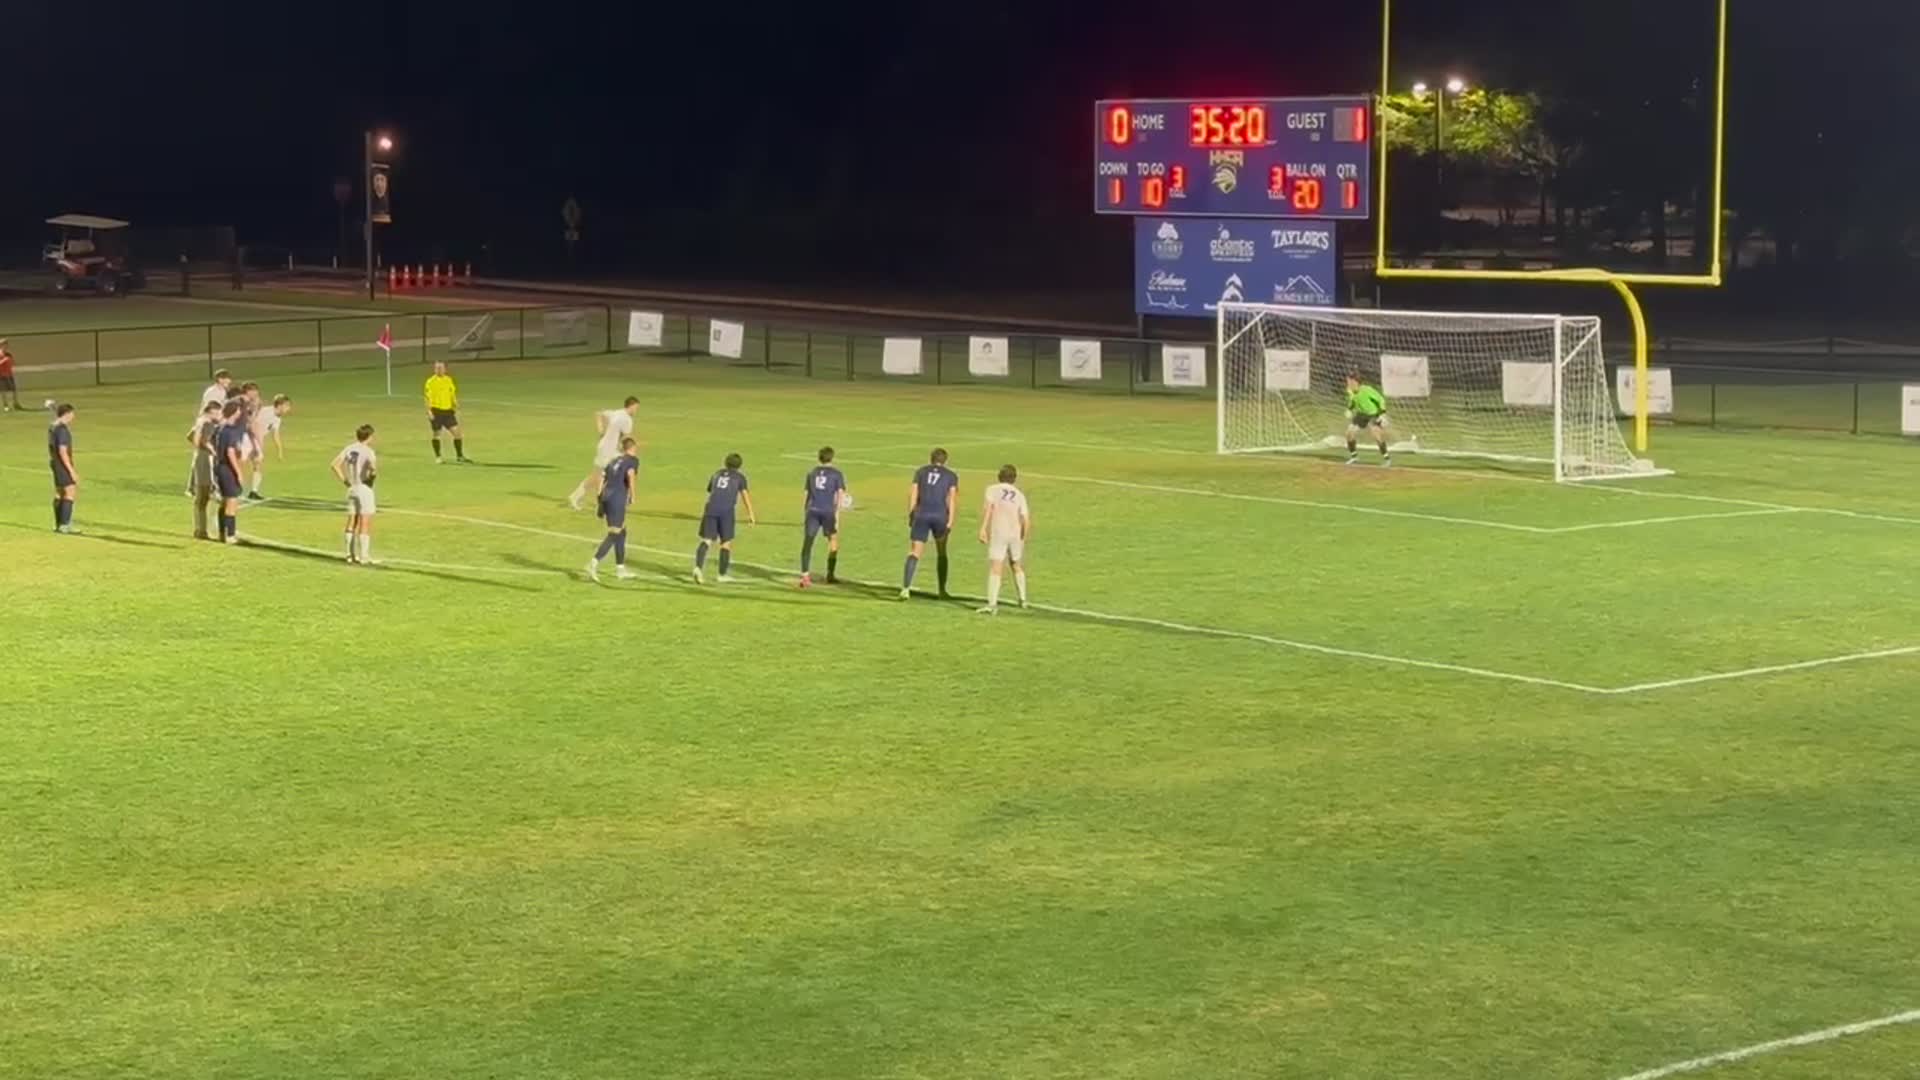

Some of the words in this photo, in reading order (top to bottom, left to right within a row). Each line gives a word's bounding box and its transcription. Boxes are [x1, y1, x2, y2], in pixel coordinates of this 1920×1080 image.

[1112, 108, 1128, 143] 0
[1132, 114, 1164, 129] HOME
[1192, 107, 1264, 143] 35:20
[1286, 112, 1327, 129] GUEST
[1354, 107, 1364, 141] 1
[1099, 162, 1128, 176] DOWN
[1137, 162, 1150, 176] TO
[1150, 162, 1165, 176] GO
[1172, 166, 1184, 188] 3
[1271, 166, 1283, 189] 3
[1286, 163, 1310, 177] BALL
[1310, 164, 1326, 178] ON
[1336, 164, 1357, 179] QTR
[1112, 179, 1121, 204] 1
[1145, 178, 1163, 207] 10
[1293, 179, 1320, 209] 20
[1271, 229, 1329, 250] TAYLOR'S
[716, 476, 730, 488] 15
[815, 476, 827, 490] 12
[927, 472, 940, 485] 17
[1001, 488, 1016, 503] 22
